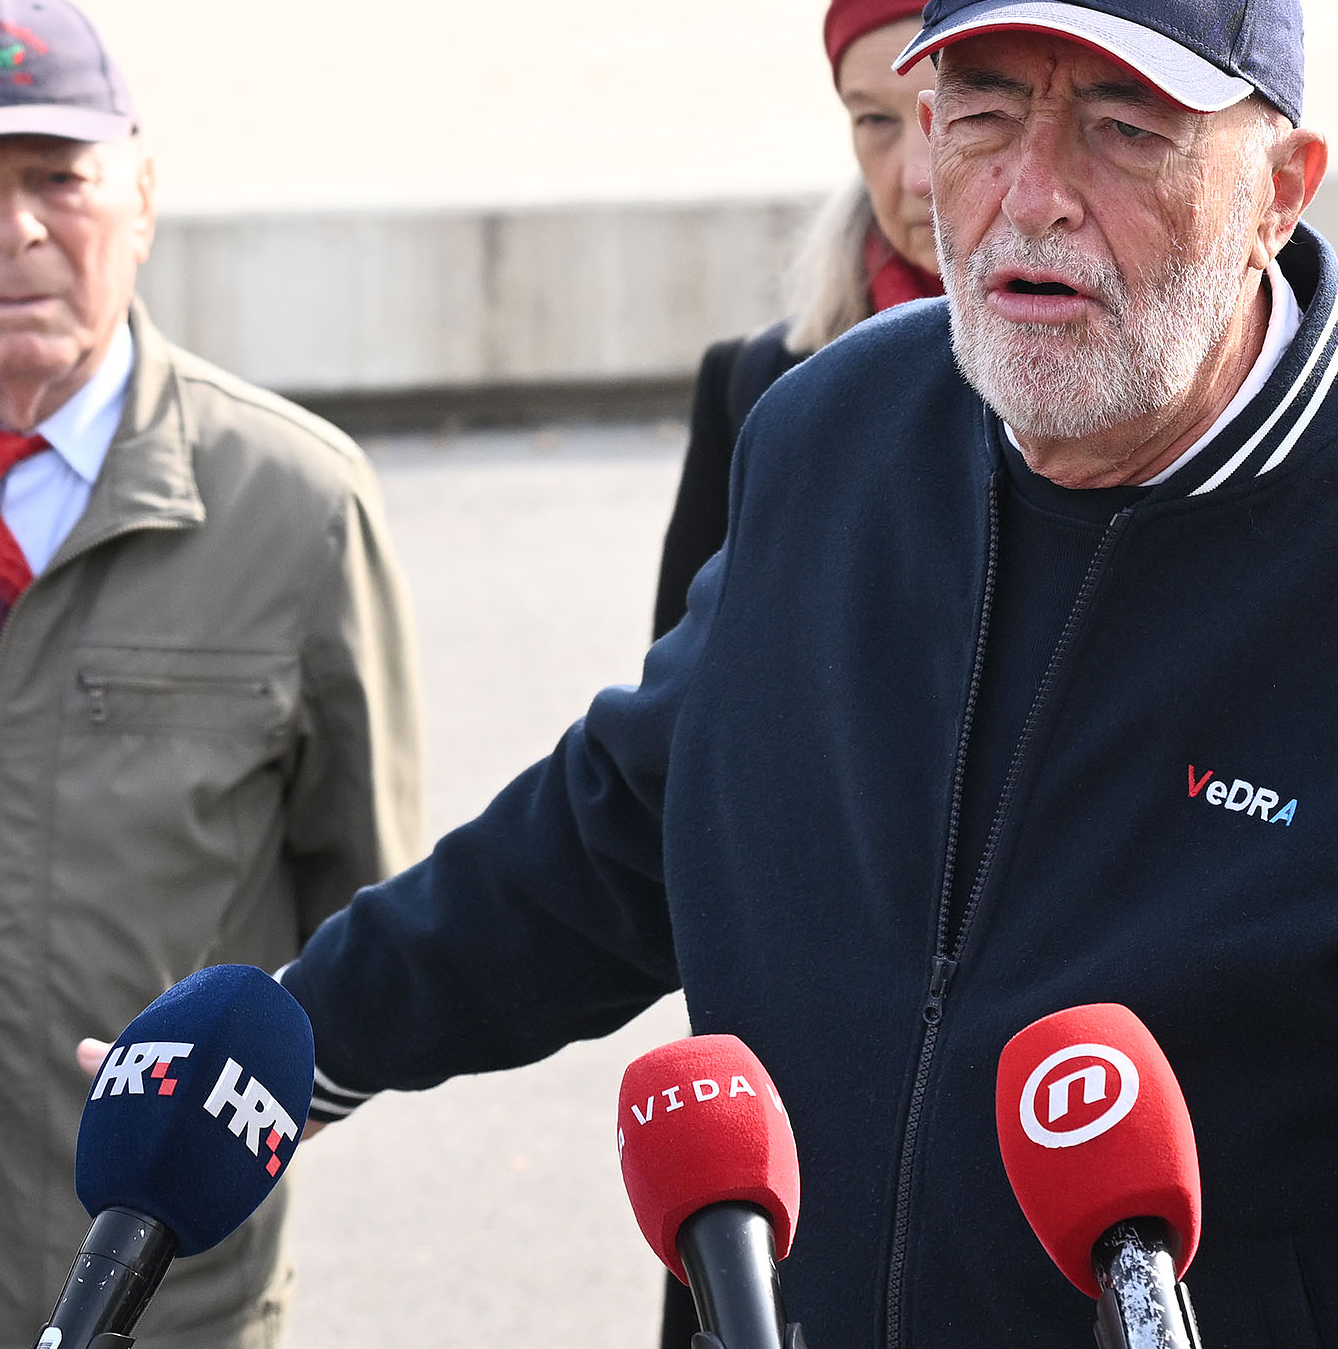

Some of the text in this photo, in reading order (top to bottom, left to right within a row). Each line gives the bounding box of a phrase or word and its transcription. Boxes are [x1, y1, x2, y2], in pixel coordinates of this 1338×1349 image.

[1187, 763, 1299, 827] VeDRA
[90, 1041, 195, 1101] HRT
[630, 1075, 757, 1126] VIDA
[202, 1056, 299, 1178] HRT
